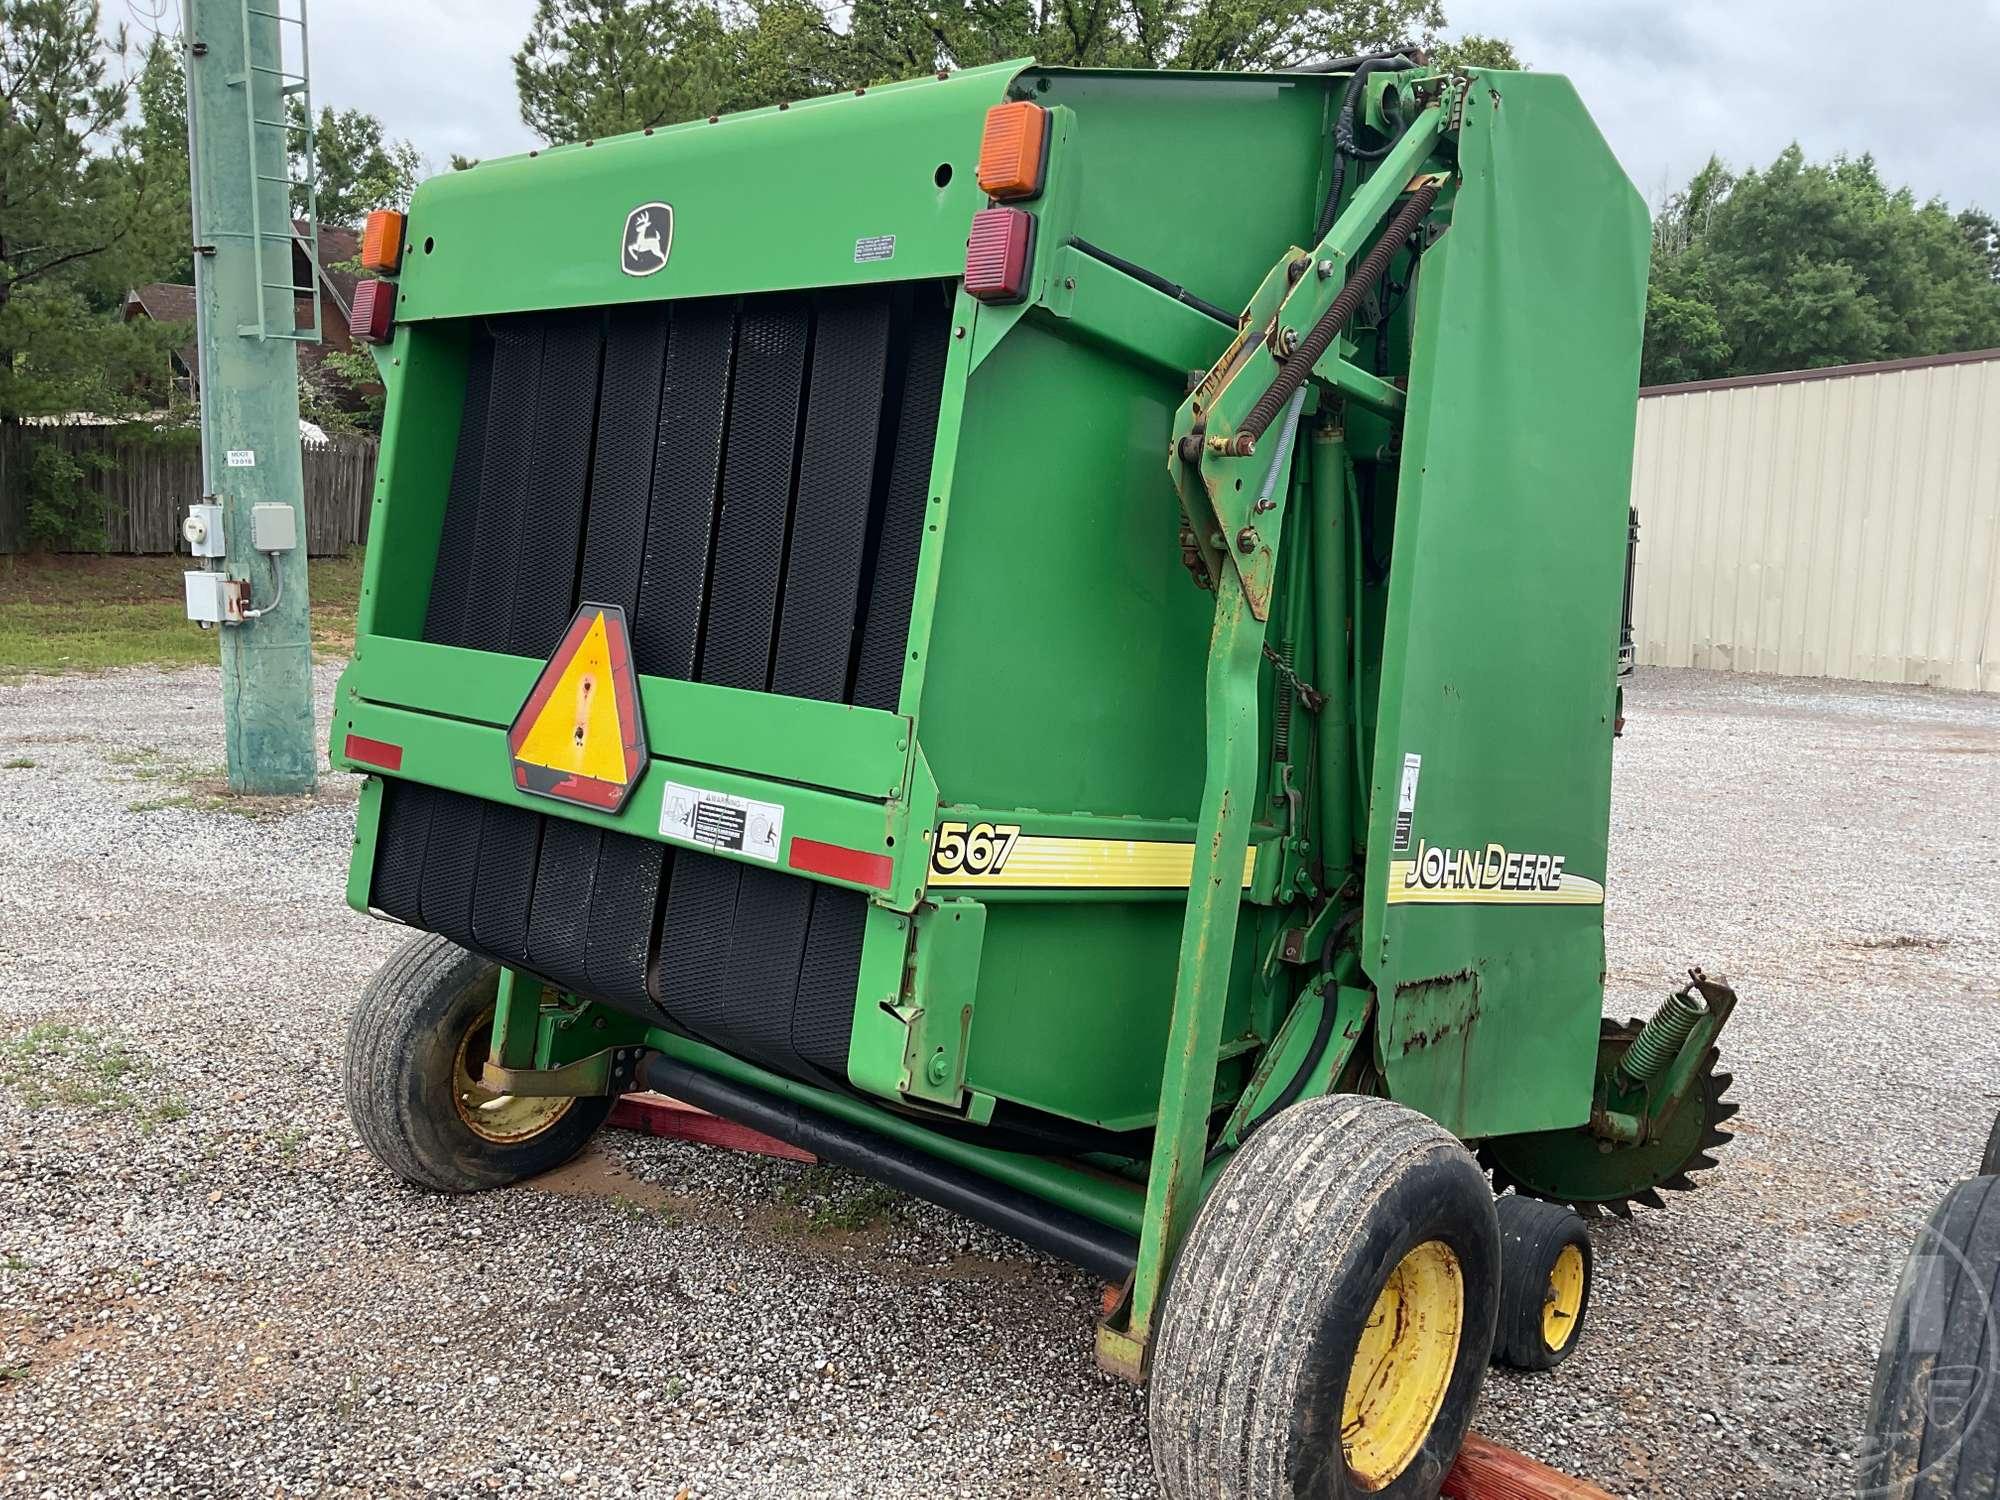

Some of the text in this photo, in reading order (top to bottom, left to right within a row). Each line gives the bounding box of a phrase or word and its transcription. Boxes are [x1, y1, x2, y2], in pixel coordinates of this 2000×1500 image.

[932, 821, 1021, 875] 567
[1405, 838, 1566, 891] JOHN DEERE
